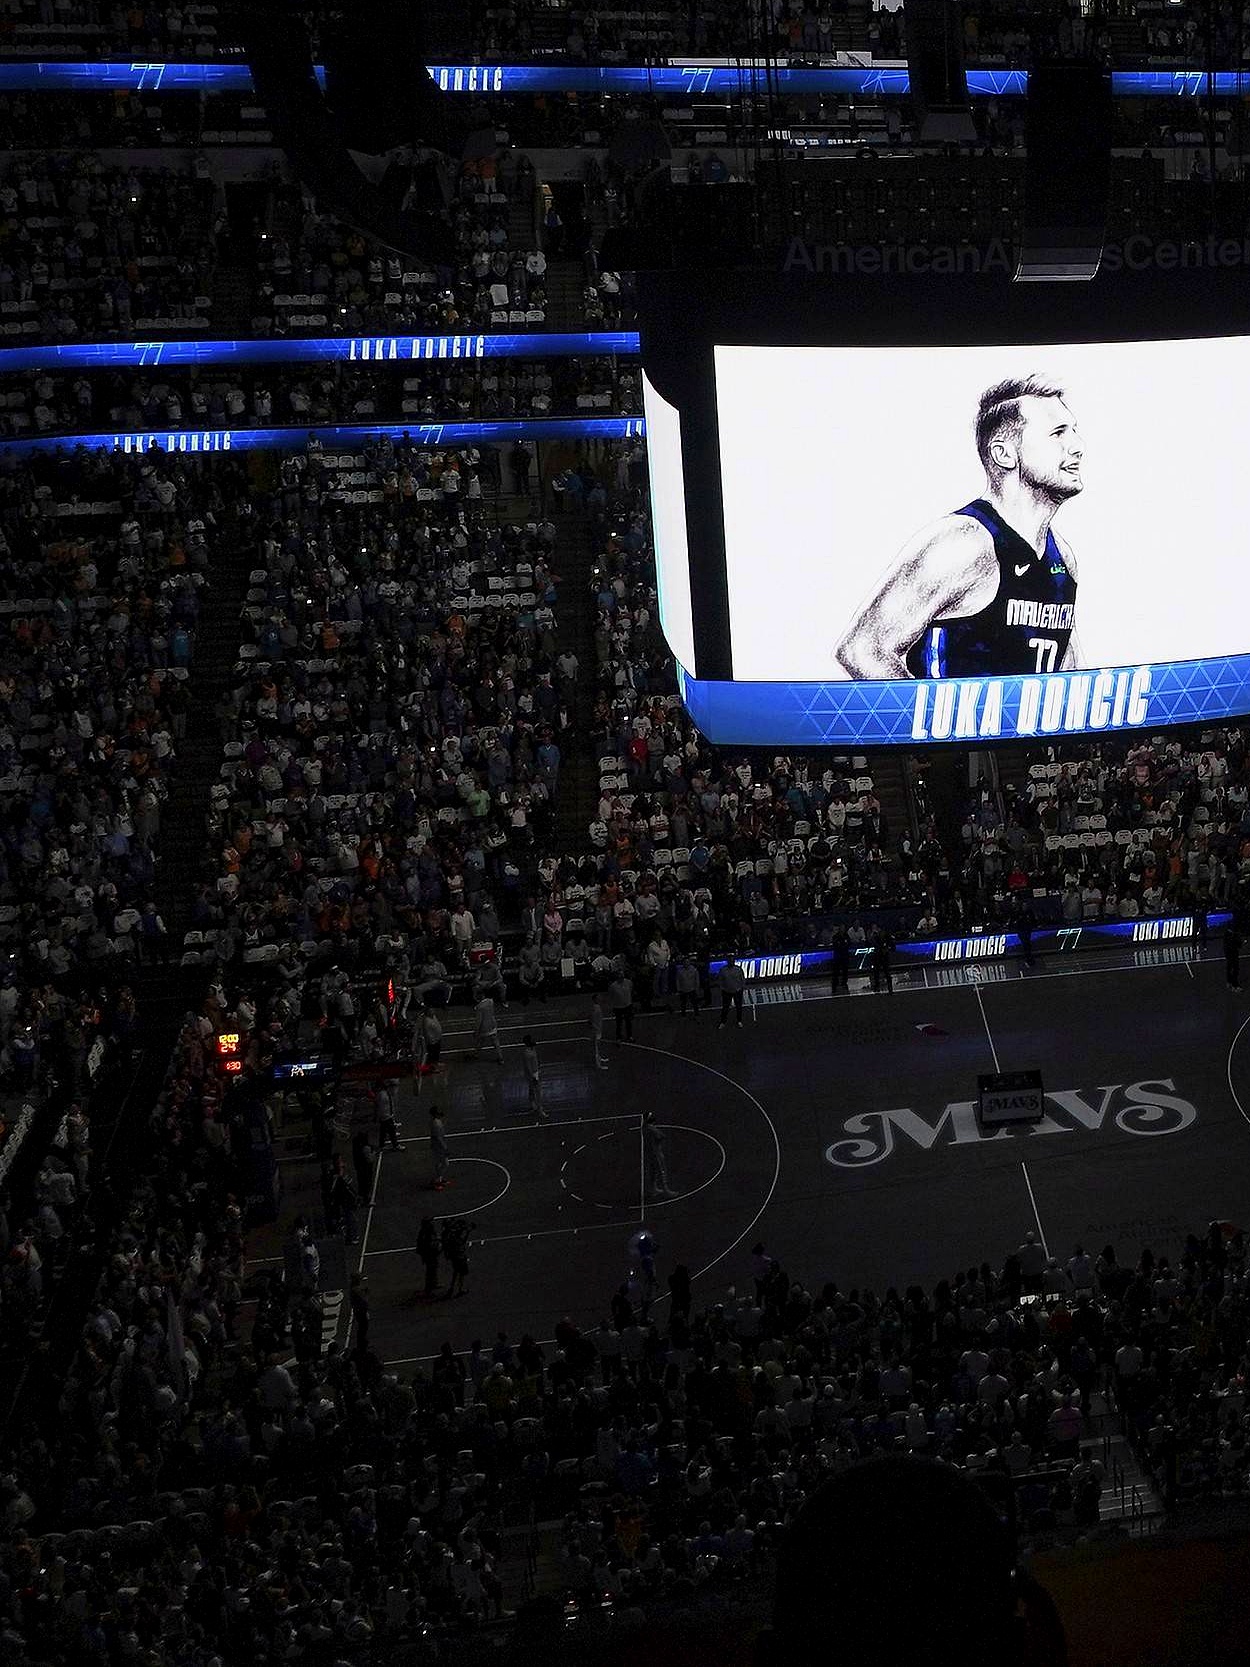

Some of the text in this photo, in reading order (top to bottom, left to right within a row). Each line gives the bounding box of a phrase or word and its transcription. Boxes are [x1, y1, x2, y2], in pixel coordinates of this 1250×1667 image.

[130, 63, 165, 90] 77
[427, 66, 503, 91] ONČIĆ
[681, 68, 713, 93] 77
[1173, 72, 1203, 96] 77
[133, 342, 164, 365] 77
[350, 340, 398, 360] LUKA
[420, 425, 444, 444] 77
[1028, 638, 1059, 673] 77
[911, 681, 1002, 740] LUKA
[1056, 928, 1083, 950] 77
[1132, 921, 1159, 941] LUKA
[934, 940, 962, 961] LUKA
